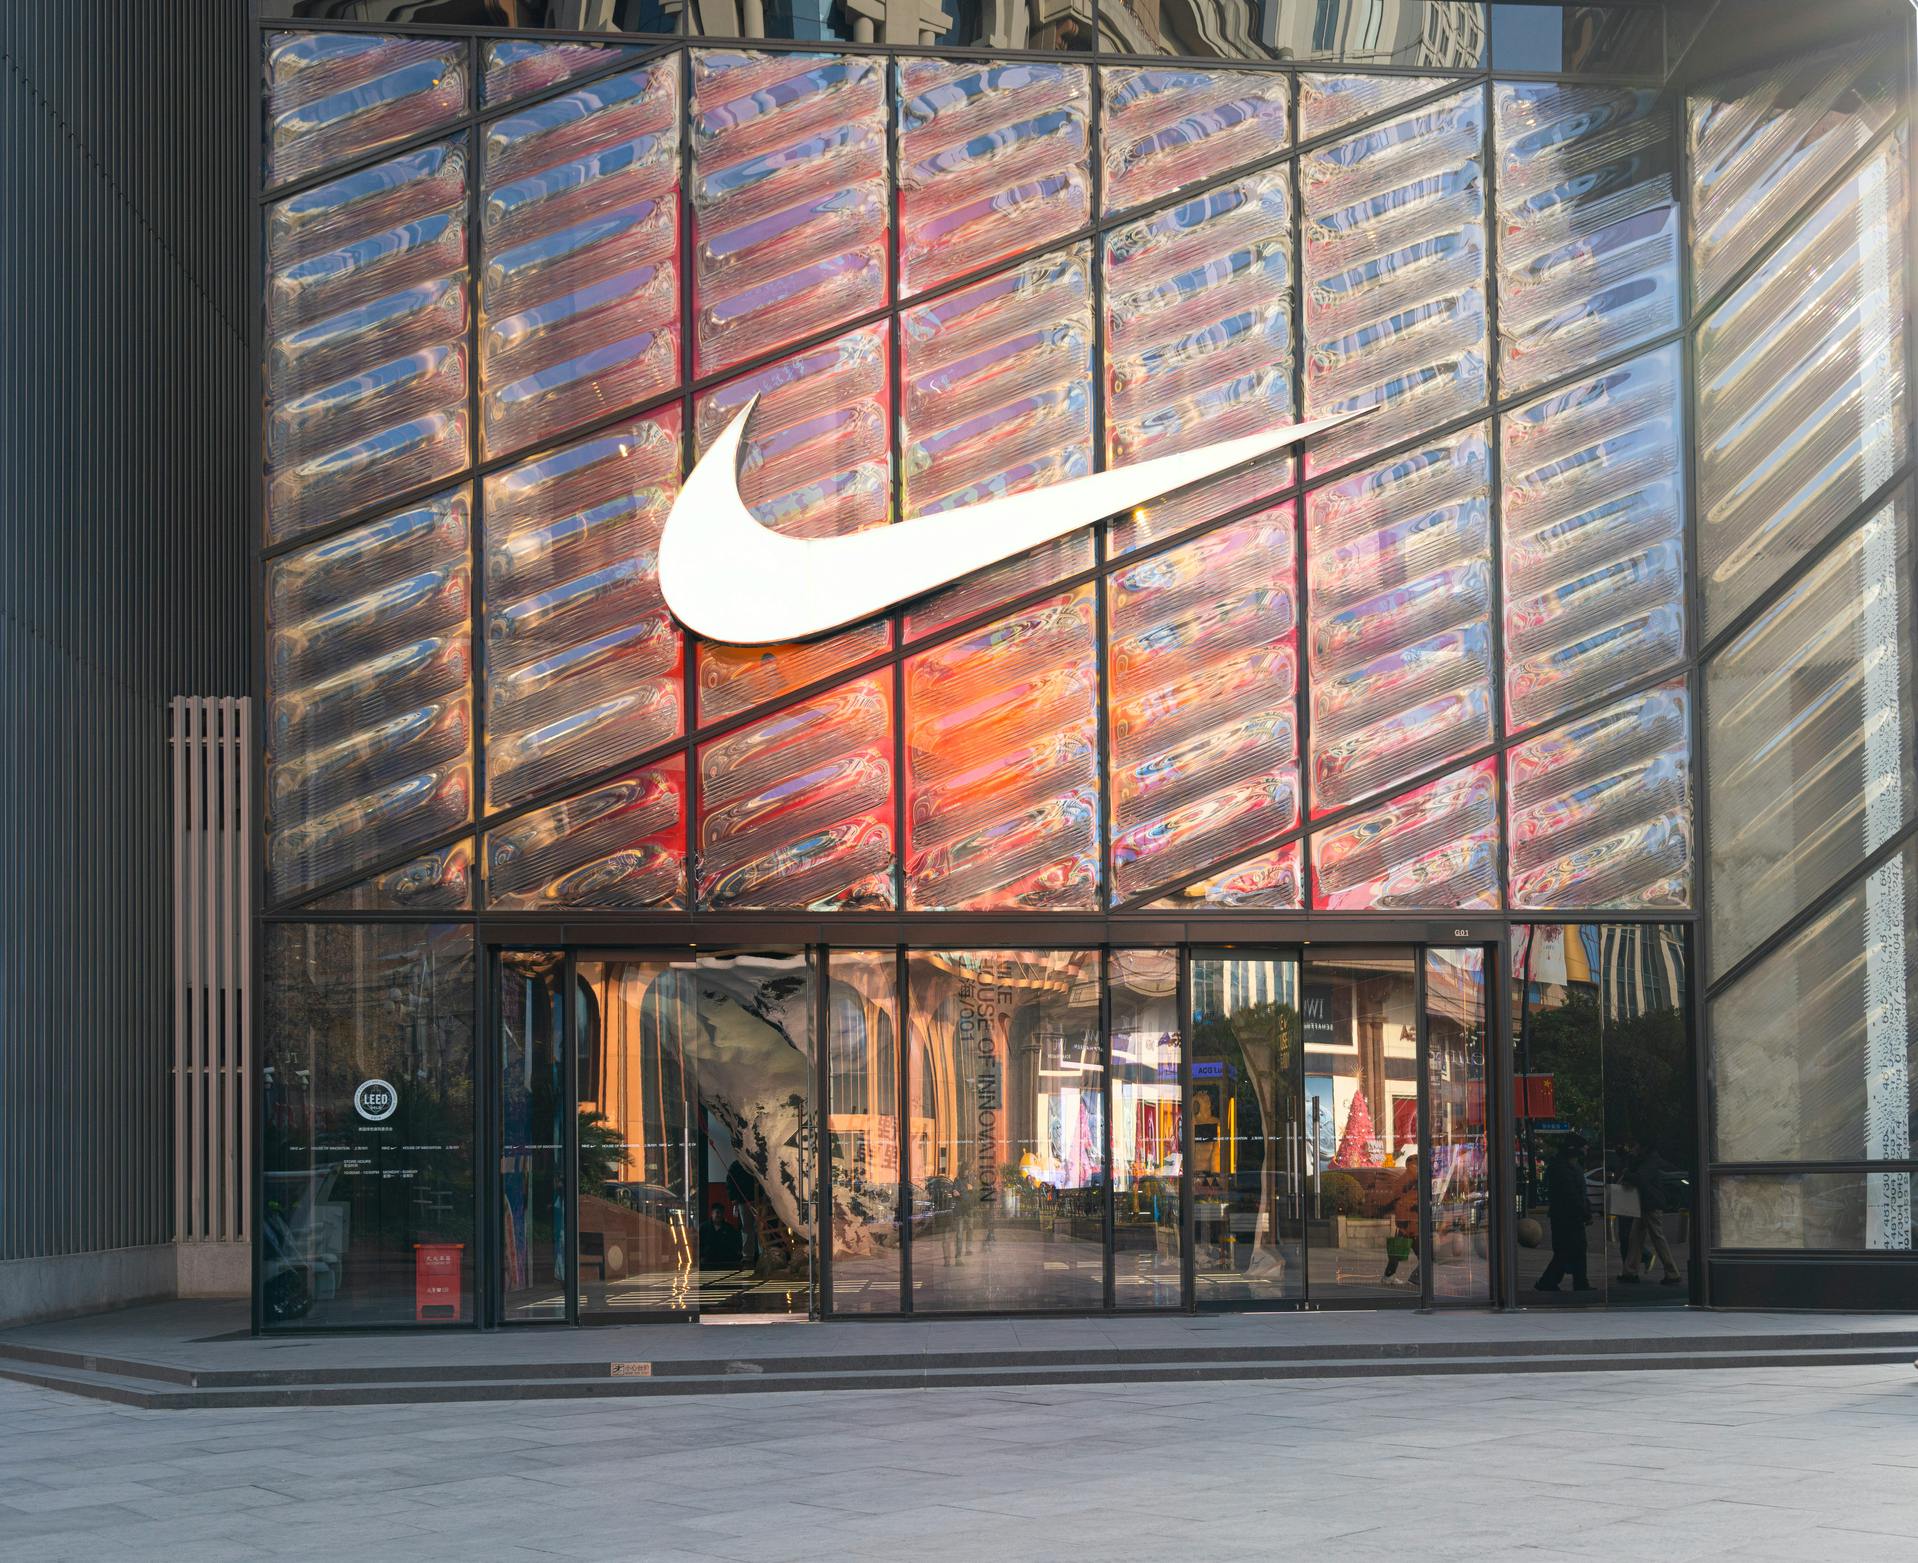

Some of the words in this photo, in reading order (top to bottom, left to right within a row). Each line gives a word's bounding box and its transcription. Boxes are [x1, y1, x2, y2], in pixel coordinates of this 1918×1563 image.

[1454, 929, 1469, 937] G01
[978, 1038, 996, 1067] OF
[364, 1094, 388, 1104] LEED
[978, 1074, 998, 1202] INNOVATION
